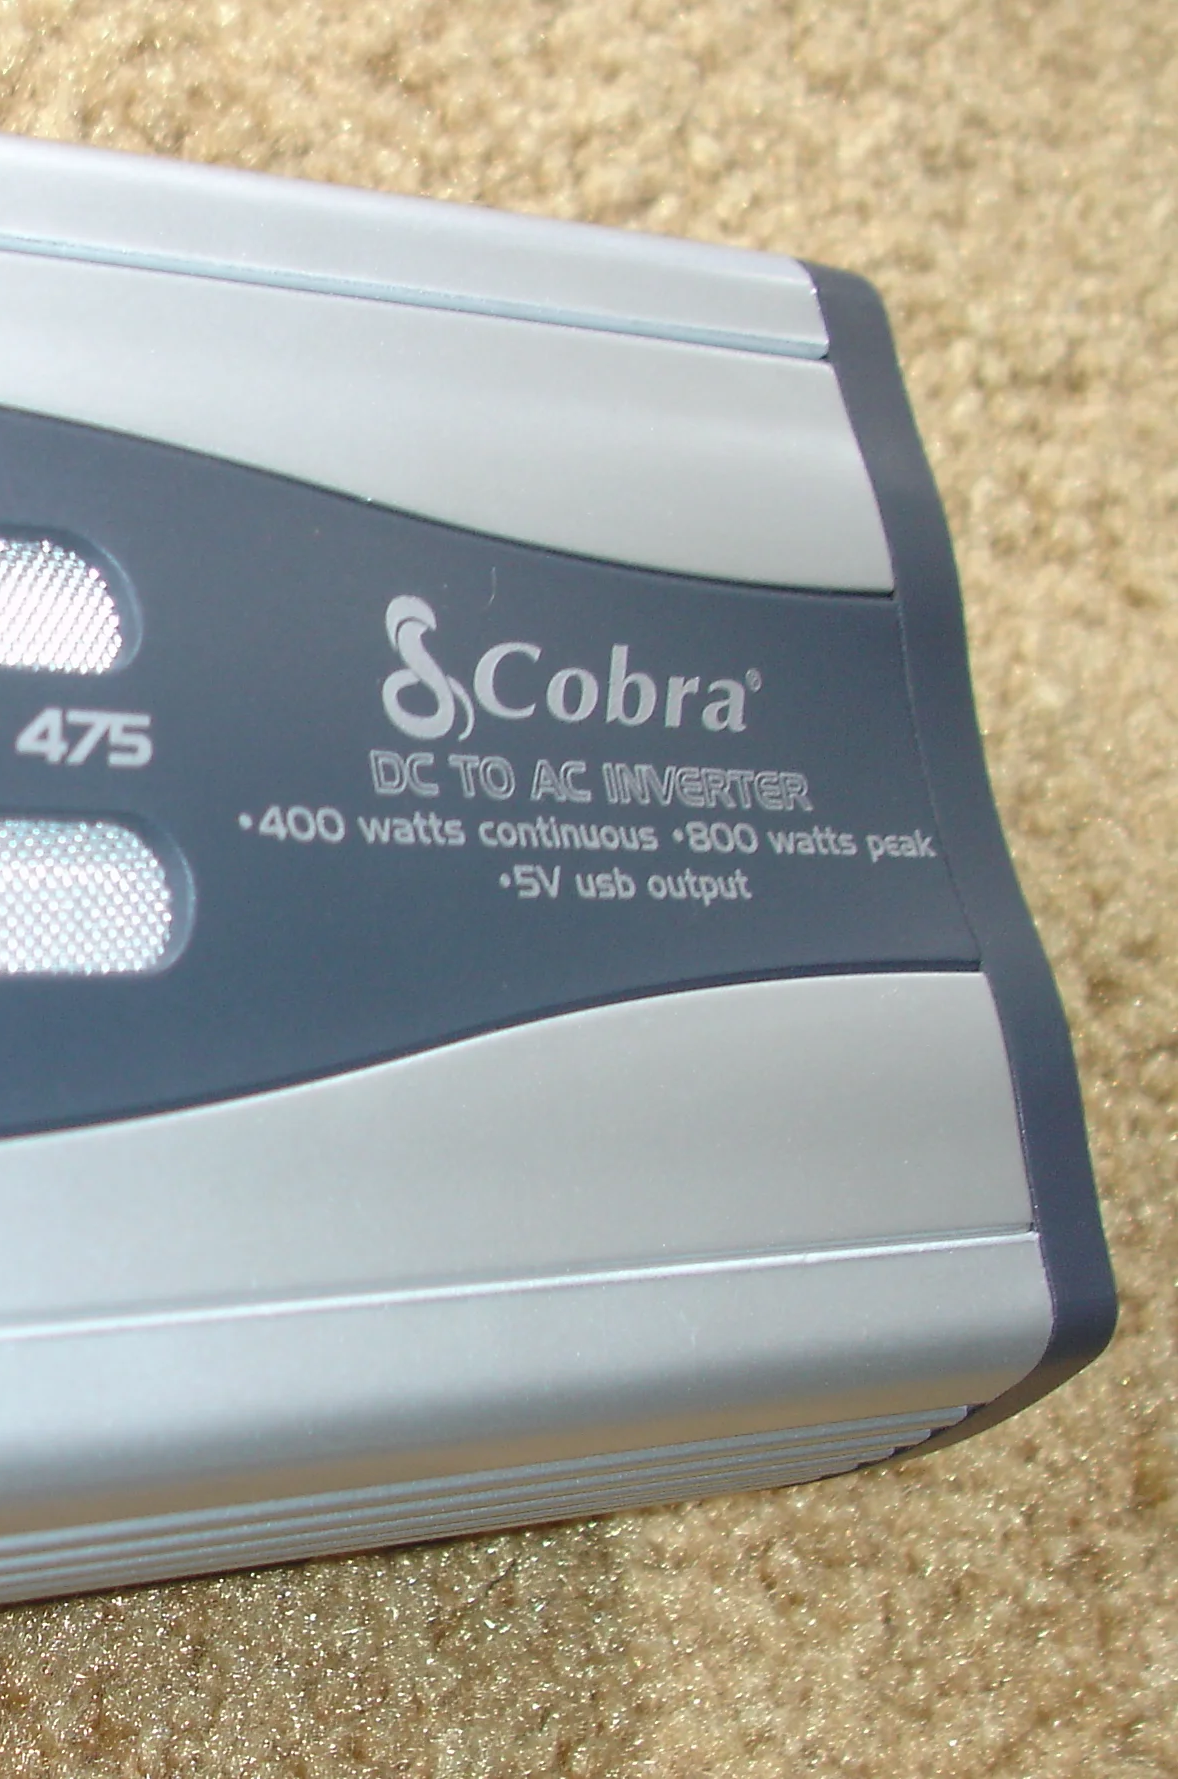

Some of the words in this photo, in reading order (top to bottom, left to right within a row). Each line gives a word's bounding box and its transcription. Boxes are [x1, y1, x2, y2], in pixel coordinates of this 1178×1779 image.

[15, 707, 153, 767] 475
[369, 750, 440, 797] DC
[448, 754, 517, 801] TO
[529, 758, 592, 803] AC
[602, 762, 814, 813] INVERTER
[356, 811, 467, 847] watts
[477, 815, 659, 851] continuous
[767, 826, 859, 857] watts
[866, 829, 937, 863] peak
[574, 867, 637, 900] usb
[646, 868, 754, 907] output
